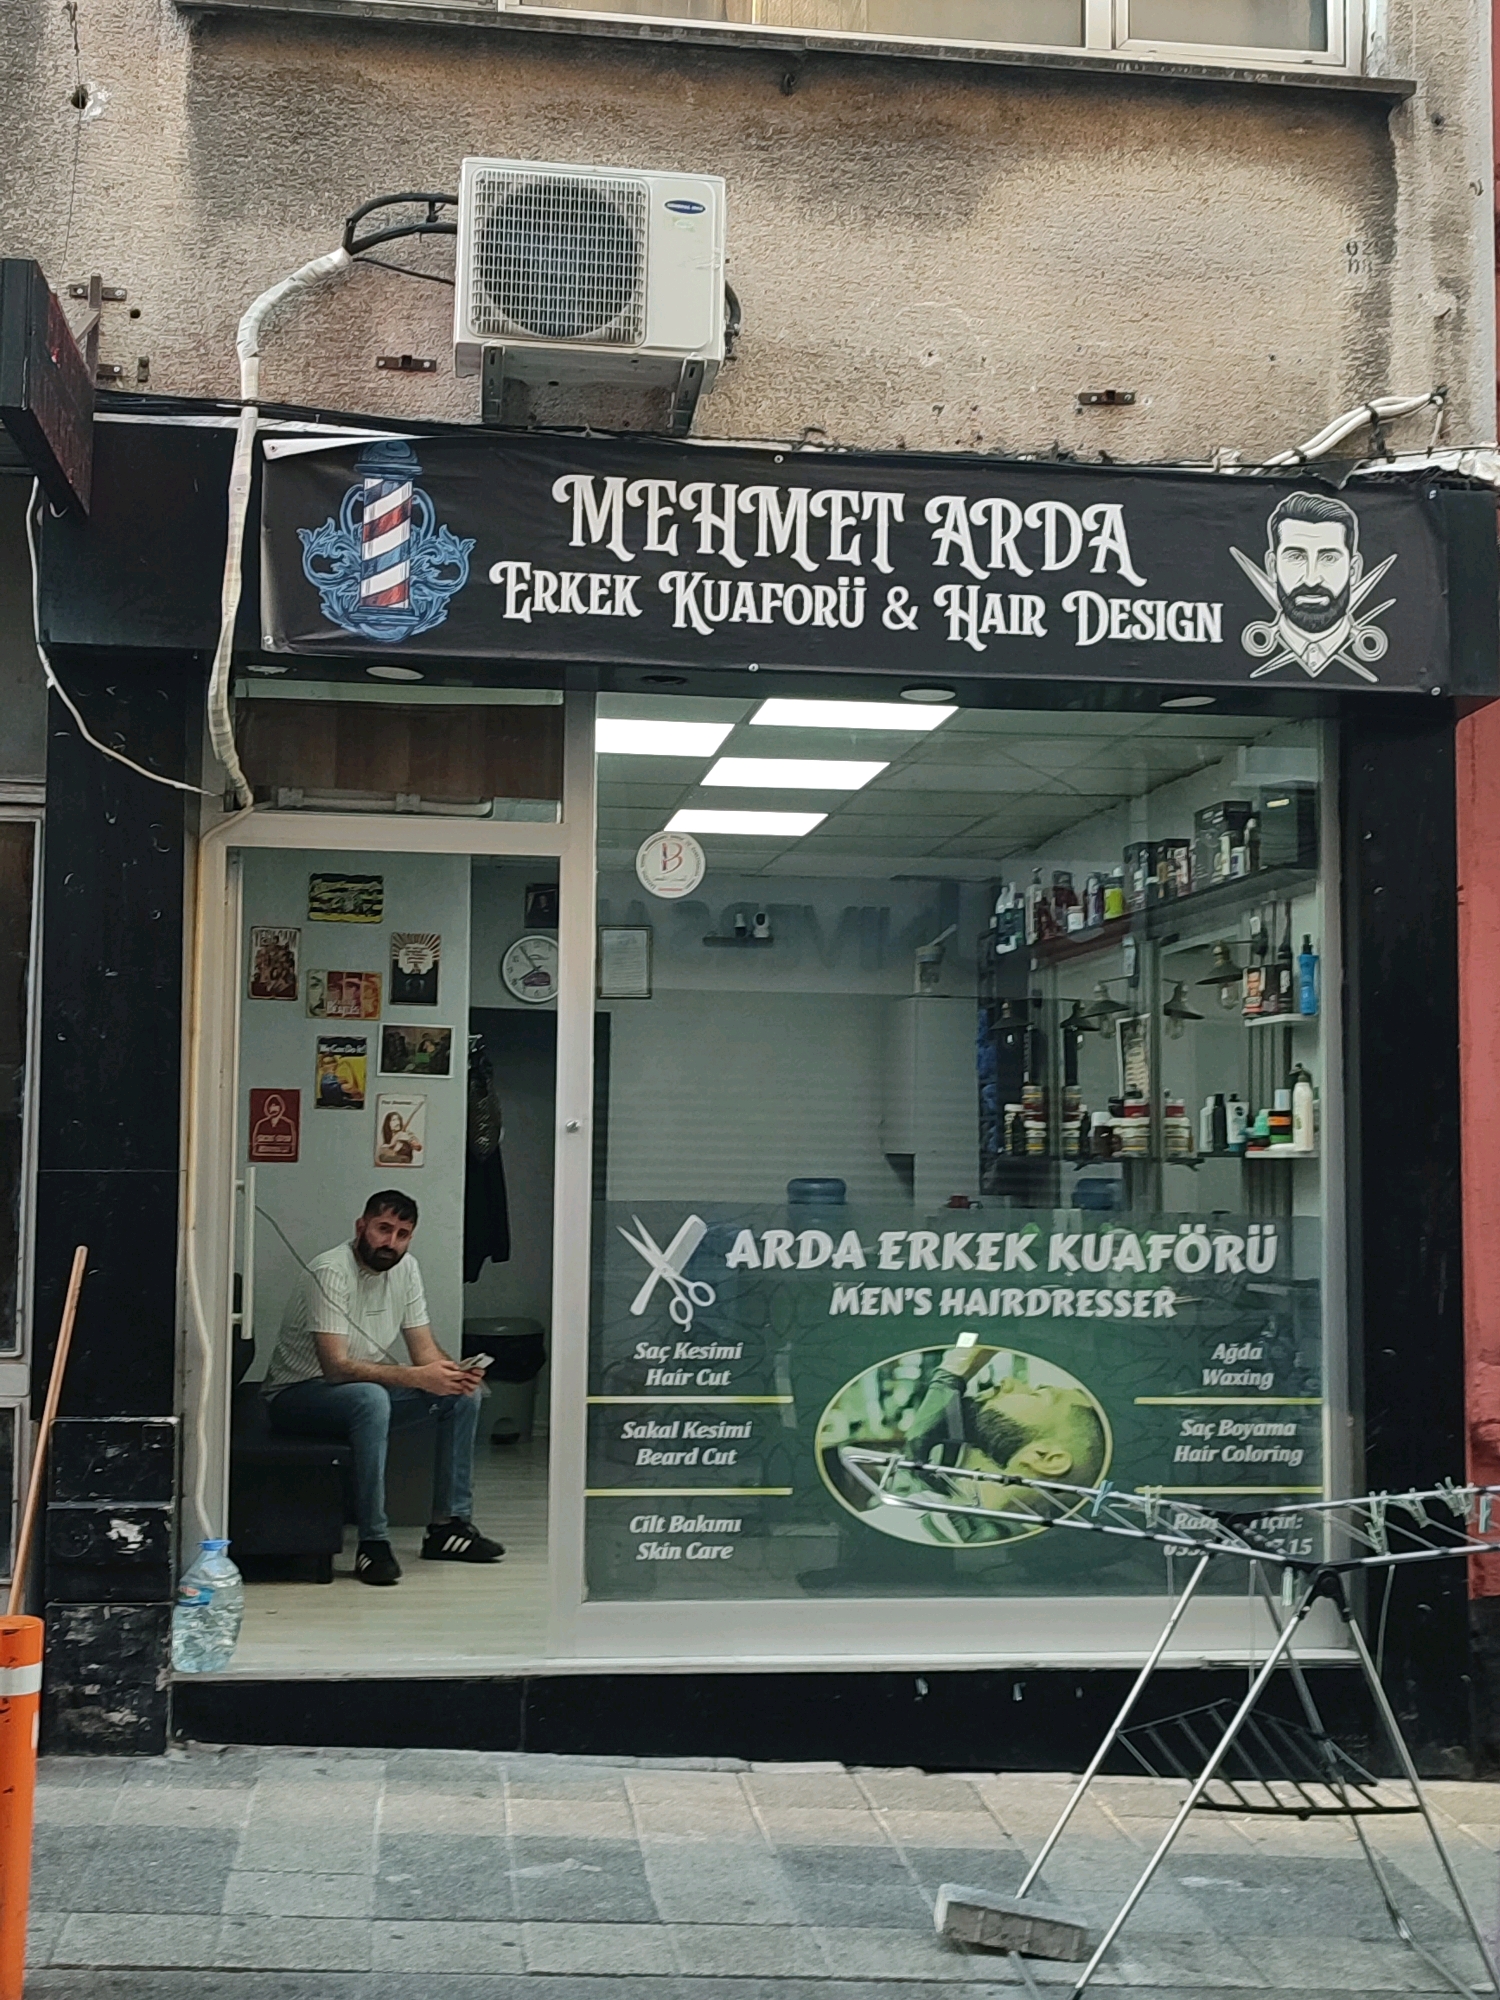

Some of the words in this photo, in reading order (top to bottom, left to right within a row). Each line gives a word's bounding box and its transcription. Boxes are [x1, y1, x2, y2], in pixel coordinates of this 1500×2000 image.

[551, 473, 906, 574] MEHMET
[924, 494, 1148, 588] ARDA
[488, 560, 643, 623] ERKEK
[881, 585, 919, 632] &
[933, 583, 1049, 652] HAIR
[1061, 590, 1224, 647] DESIGN
[725, 1228, 867, 1270] ARDA
[877, 1230, 1038, 1272] ERKEK
[1047, 1223, 1279, 1275] KUAFÖRÜ
[828, 1286, 933, 1317] MEN'S
[939, 1287, 1178, 1319] HAIRDRESSER
[633, 1342, 671, 1364] Saç
[672, 1342, 744, 1360] Kesimi
[1211, 1343, 1263, 1365] Ağda
[644, 1368, 694, 1386] Hair
[695, 1368, 732, 1386] Cut
[1202, 1369, 1275, 1391] Waxing
[620, 1421, 681, 1440] Sakal
[681, 1421, 753, 1440] Kesimi
[1179, 1419, 1216, 1441] Saç
[1216, 1419, 1298, 1441] Boyama
[635, 1447, 700, 1466] Beard
[701, 1447, 738, 1466] Cut
[1173, 1445, 1221, 1463] Hair
[1221, 1445, 1305, 1467] Coloring
[629, 1515, 666, 1534] Cilt
[667, 1514, 743, 1534] Bakımı
[635, 1542, 683, 1561] Skin
[685, 1542, 734, 1560] Care
